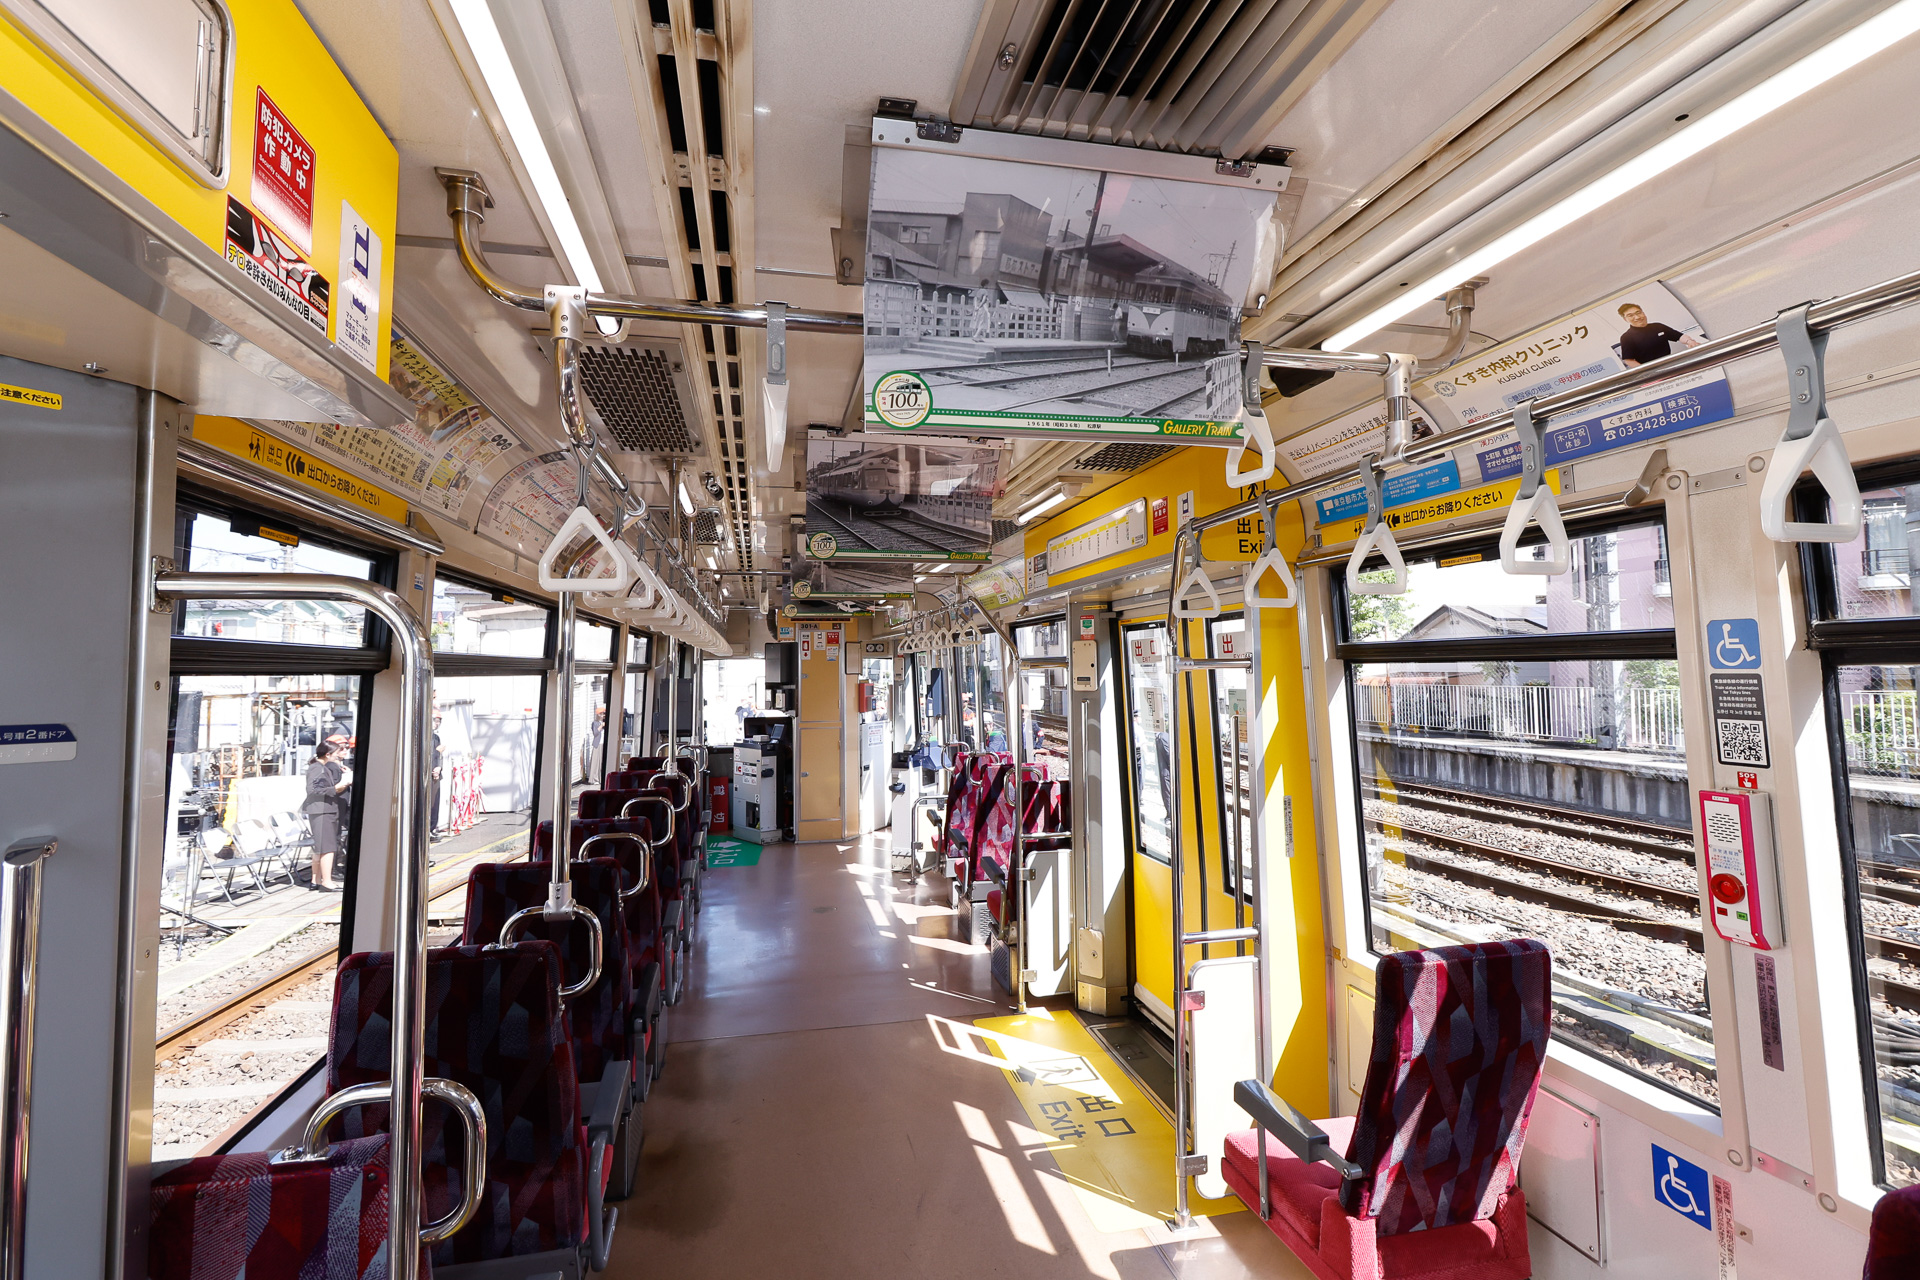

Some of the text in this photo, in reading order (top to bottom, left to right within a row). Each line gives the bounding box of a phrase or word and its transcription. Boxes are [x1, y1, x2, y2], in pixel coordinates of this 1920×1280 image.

[260, 102, 311, 170] 防犯カメラ
[263, 132, 307, 190] 作動中
[259, 154, 276, 176] Security
[275, 171, 289, 189] camera
[227, 243, 310, 322] テロを許さないみんなの目
[1454, 325, 1589, 387] くすき内科クリニック
[1497, 355, 1562, 385] KUSUKI CLINIC
[889, 392, 918, 409] 100
[1461, 406, 1478, 418] 内科
[1608, 395, 1689, 426] くすき内科 検索
[273, 418, 308, 437] -5477-0130
[1163, 420, 1233, 437] GALLERY TRAIN
[1619, 405, 1702, 438] 03-3428-8007
[1557, 429, 1586, 443] 木・日・祝
[1565, 439, 1582, 450] 休診
[269, 444, 283, 460] 出口
[266, 457, 283, 467] Exit Door
[307, 463, 380, 506] 出口からお降りください
[1333, 489, 1369, 508] 東京都市大学
[1402, 490, 1503, 524] 出口からお降りください
[950, 552, 987, 560] GALLERY TRAIN
[1239, 539, 1266, 554] Exi
[0, 729, 67, 741] 号車2番ドア
[1739, 771, 1756, 779] SOS
[1038, 1100, 1087, 1142] Exit
[1076, 1096, 1137, 1138] 出口
